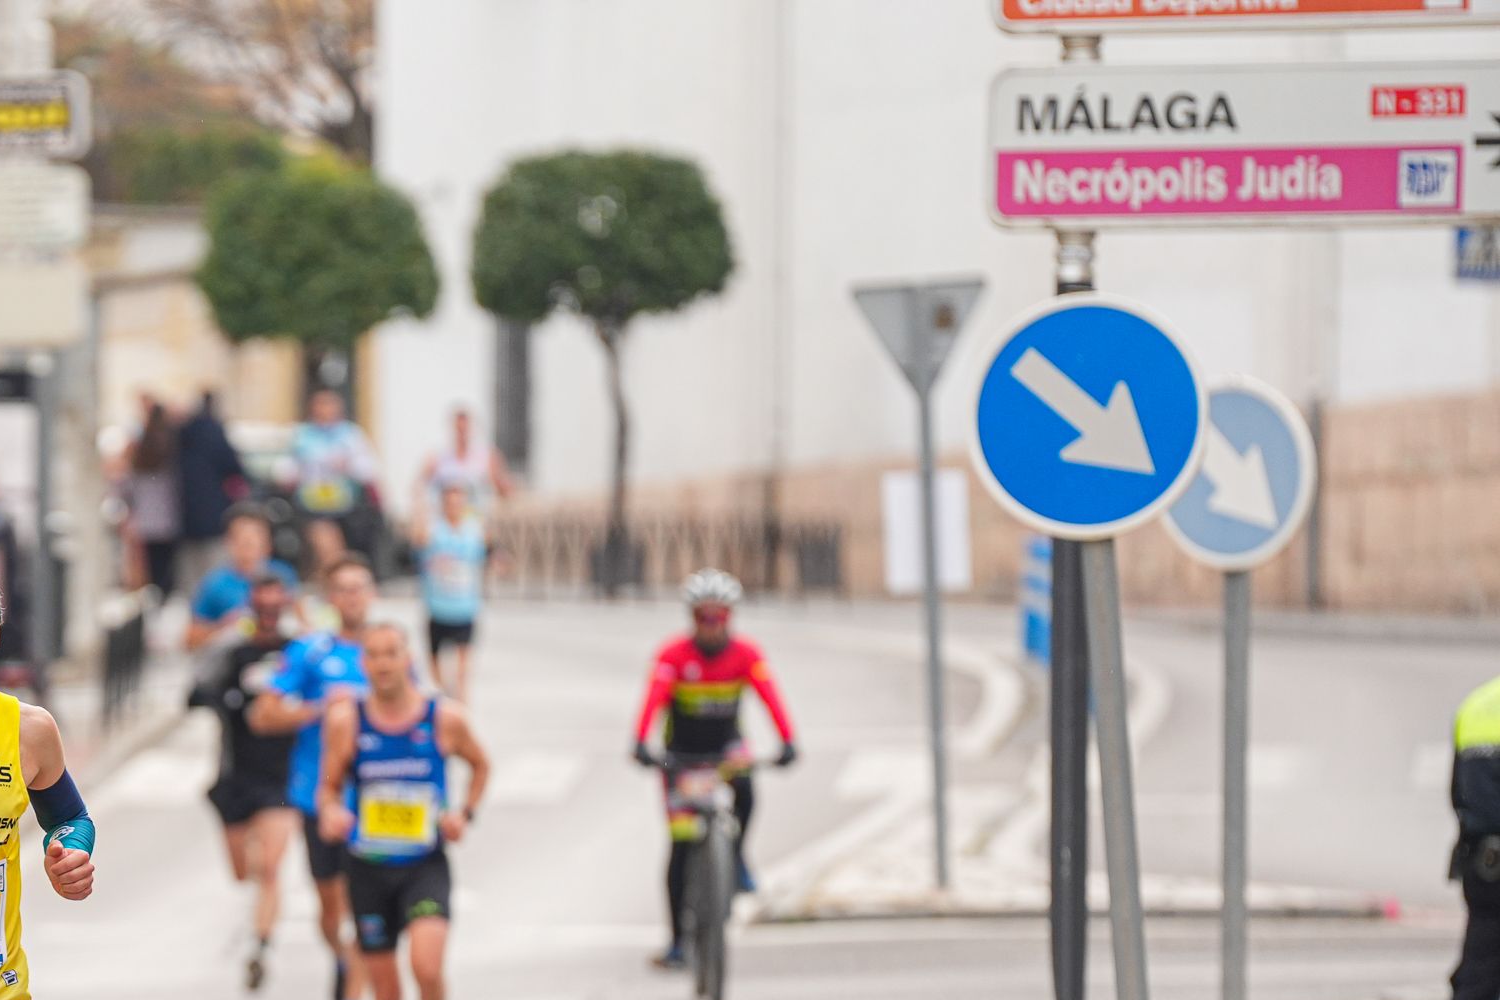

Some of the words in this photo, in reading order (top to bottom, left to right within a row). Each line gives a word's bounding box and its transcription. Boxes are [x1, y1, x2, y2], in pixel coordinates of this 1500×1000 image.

[1016, 84, 1238, 133] MÁLAGA
[1012, 157, 1228, 210] Necrópolis
[1236, 155, 1343, 201] Judía
